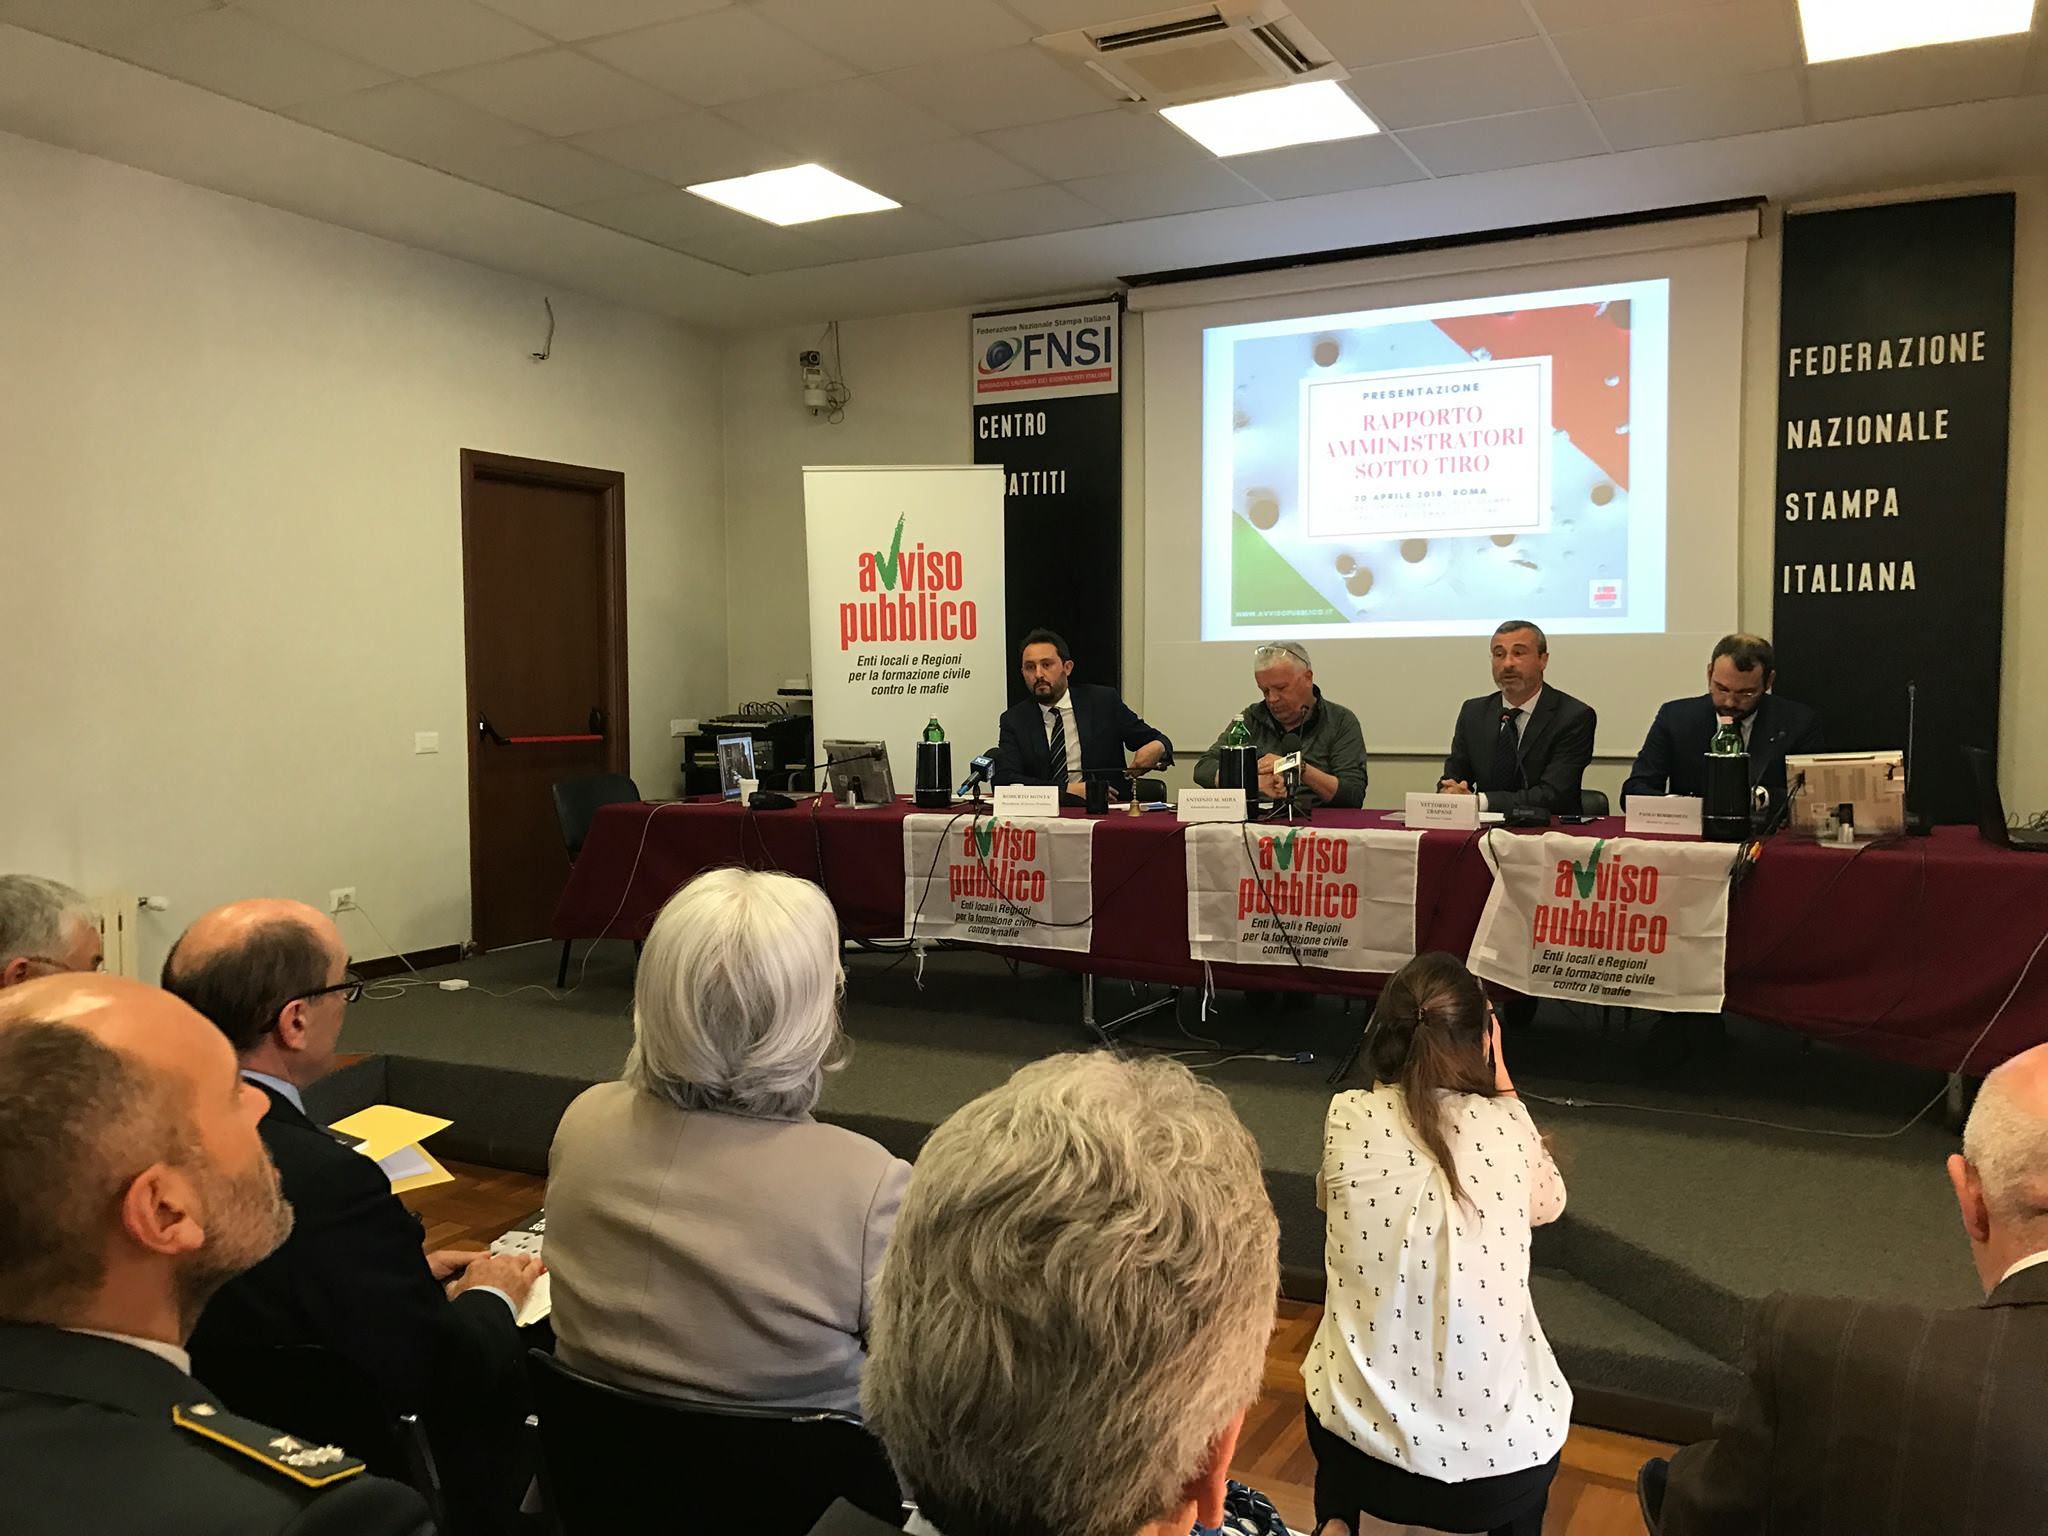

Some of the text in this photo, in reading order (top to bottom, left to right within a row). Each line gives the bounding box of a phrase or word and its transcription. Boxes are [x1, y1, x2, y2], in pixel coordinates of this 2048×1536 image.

[976, 314, 1111, 335] Federazione Nazionale Stampa Italiana
[1024, 326, 1111, 371] FNSI
[1789, 331, 1985, 378] FEDERAZIONE
[1362, 382, 1480, 400] PRESENTAZIONE
[979, 411, 1046, 439] CENTRO
[1363, 405, 1483, 432] RAPPORTO
[1787, 408, 1949, 450] NAZIONALE
[1327, 427, 1524, 459] AMMINISTRATORI
[1354, 454, 1490, 479] SOTTO TIRO
[1372, 492, 1411, 501] APRILE
[1452, 488, 1487, 496] ROMA
[1784, 487, 1900, 522] STAMPA
[1783, 560, 1916, 594] ITALIANA
[840, 592, 977, 651] pubblico
[857, 653, 962, 668] Enti locali e Regioni
[848, 668, 971, 683] per la formazione civile
[871, 682, 949, 696] contro le mafie
[950, 858, 1046, 903] pubblico
[961, 900, 974, 909] Enti
[1237, 871, 1358, 921] pubblico
[955, 912, 966, 921] per
[1251, 918, 1269, 928] Enti
[1271, 919, 1296, 930] locali
[1304, 921, 1342, 934] Regioni
[1532, 899, 1668, 955] pubblico
[968, 925, 989, 935] contro
[1242, 931, 1349, 947] per la formazione civile
[1303, 948, 1329, 958] mafie
[1542, 949, 1648, 971] Enti locali e Regioni
[1532, 964, 1655, 985] per la formazione civile
[1553, 980, 1632, 997] contro le mafie
